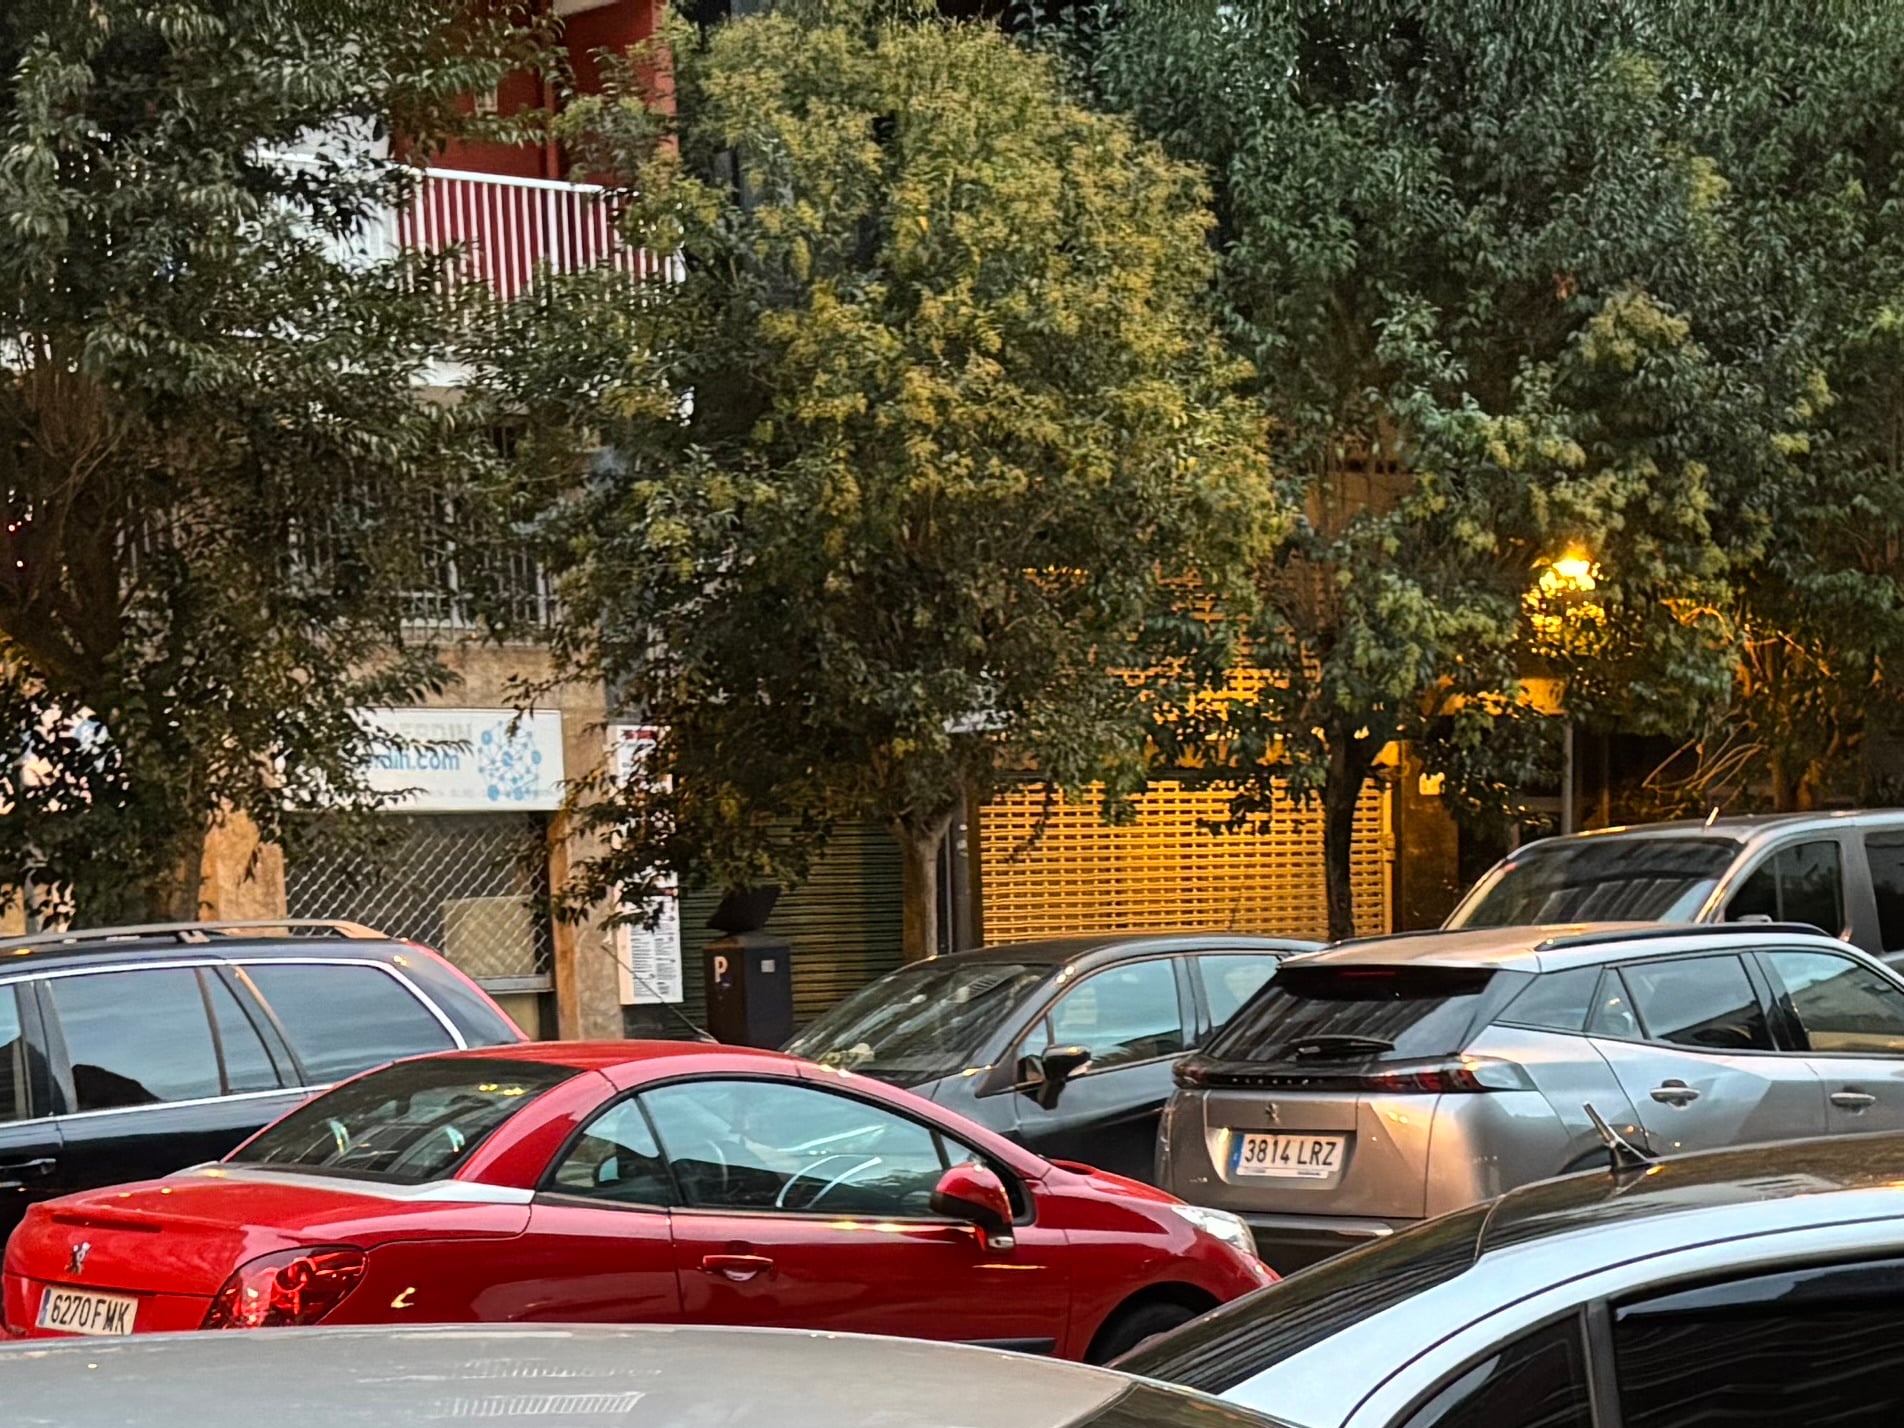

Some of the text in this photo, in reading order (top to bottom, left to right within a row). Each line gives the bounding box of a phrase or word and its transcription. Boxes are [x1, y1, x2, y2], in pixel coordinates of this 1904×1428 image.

[713, 955, 729, 983] P
[1244, 1139, 1337, 1166] 3814 LRZ
[50, 1294, 131, 1336] 6270 FMK
